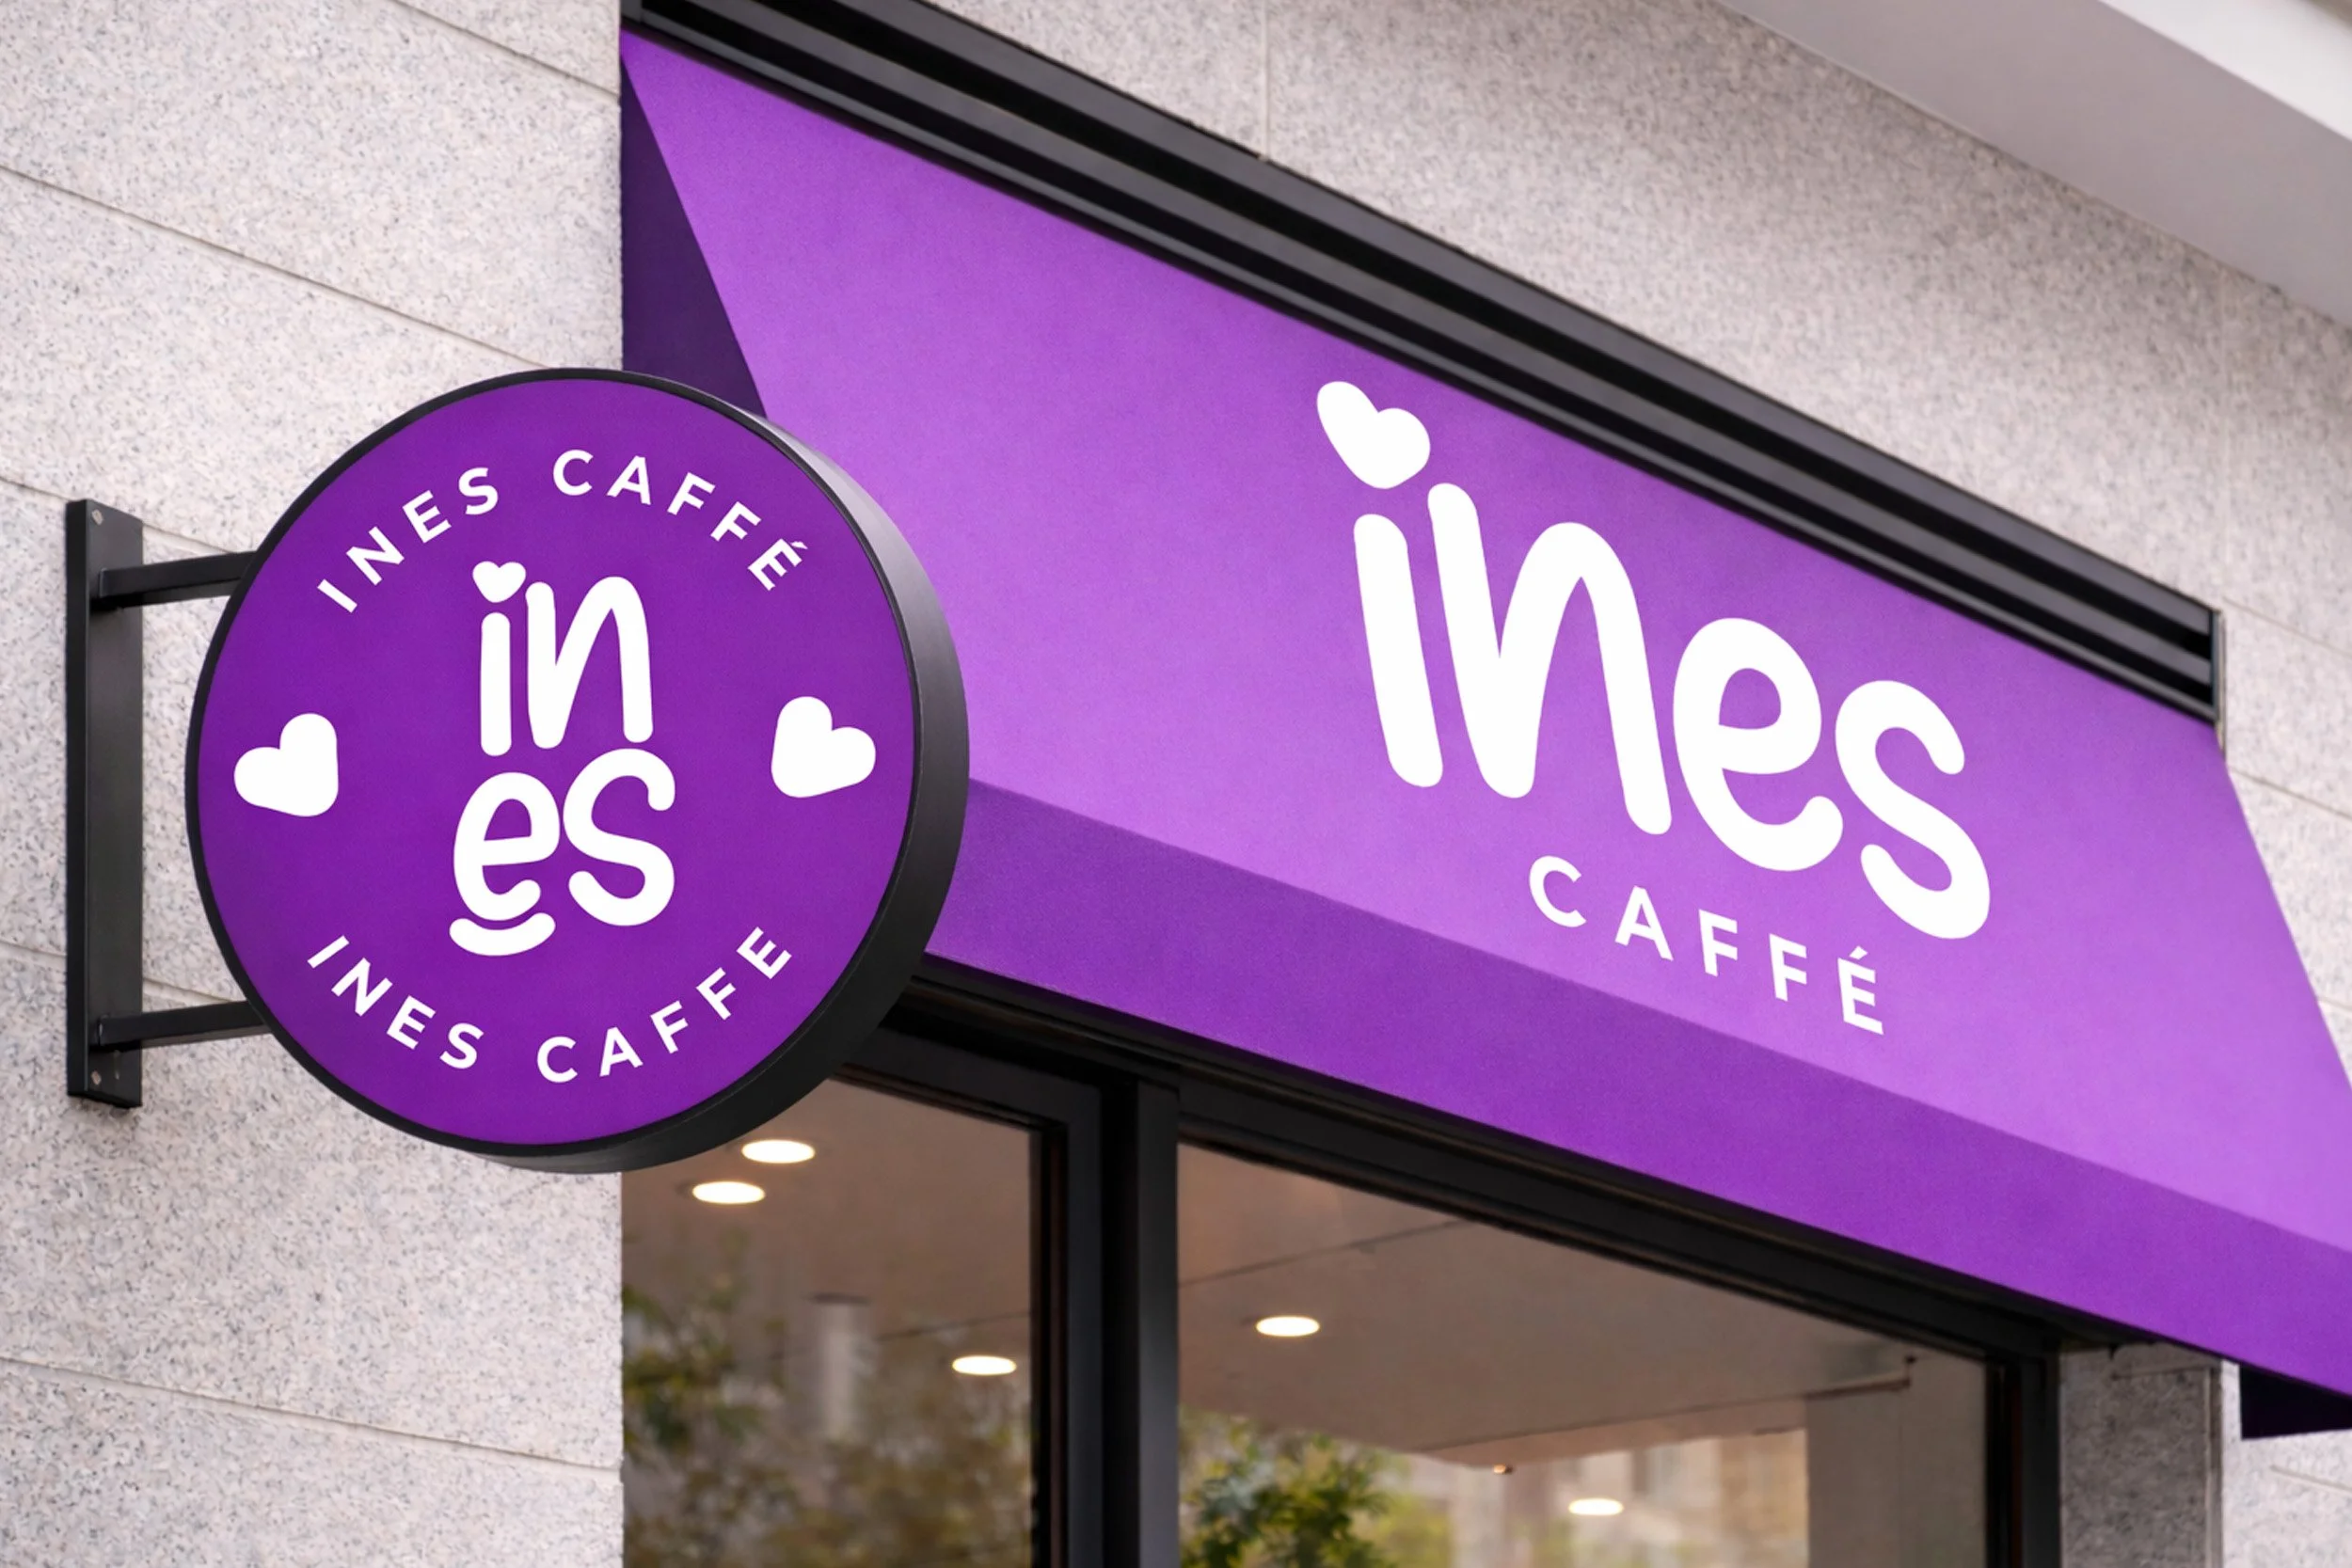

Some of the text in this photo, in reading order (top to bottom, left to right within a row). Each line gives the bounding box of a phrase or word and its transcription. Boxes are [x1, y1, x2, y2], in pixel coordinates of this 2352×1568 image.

[316, 449, 809, 614] INES CAFFÉ
[1316, 381, 1991, 940] ines
[307, 926, 792, 1084] INES CAFFE
[1529, 855, 1883, 1036] CAFFÉ
